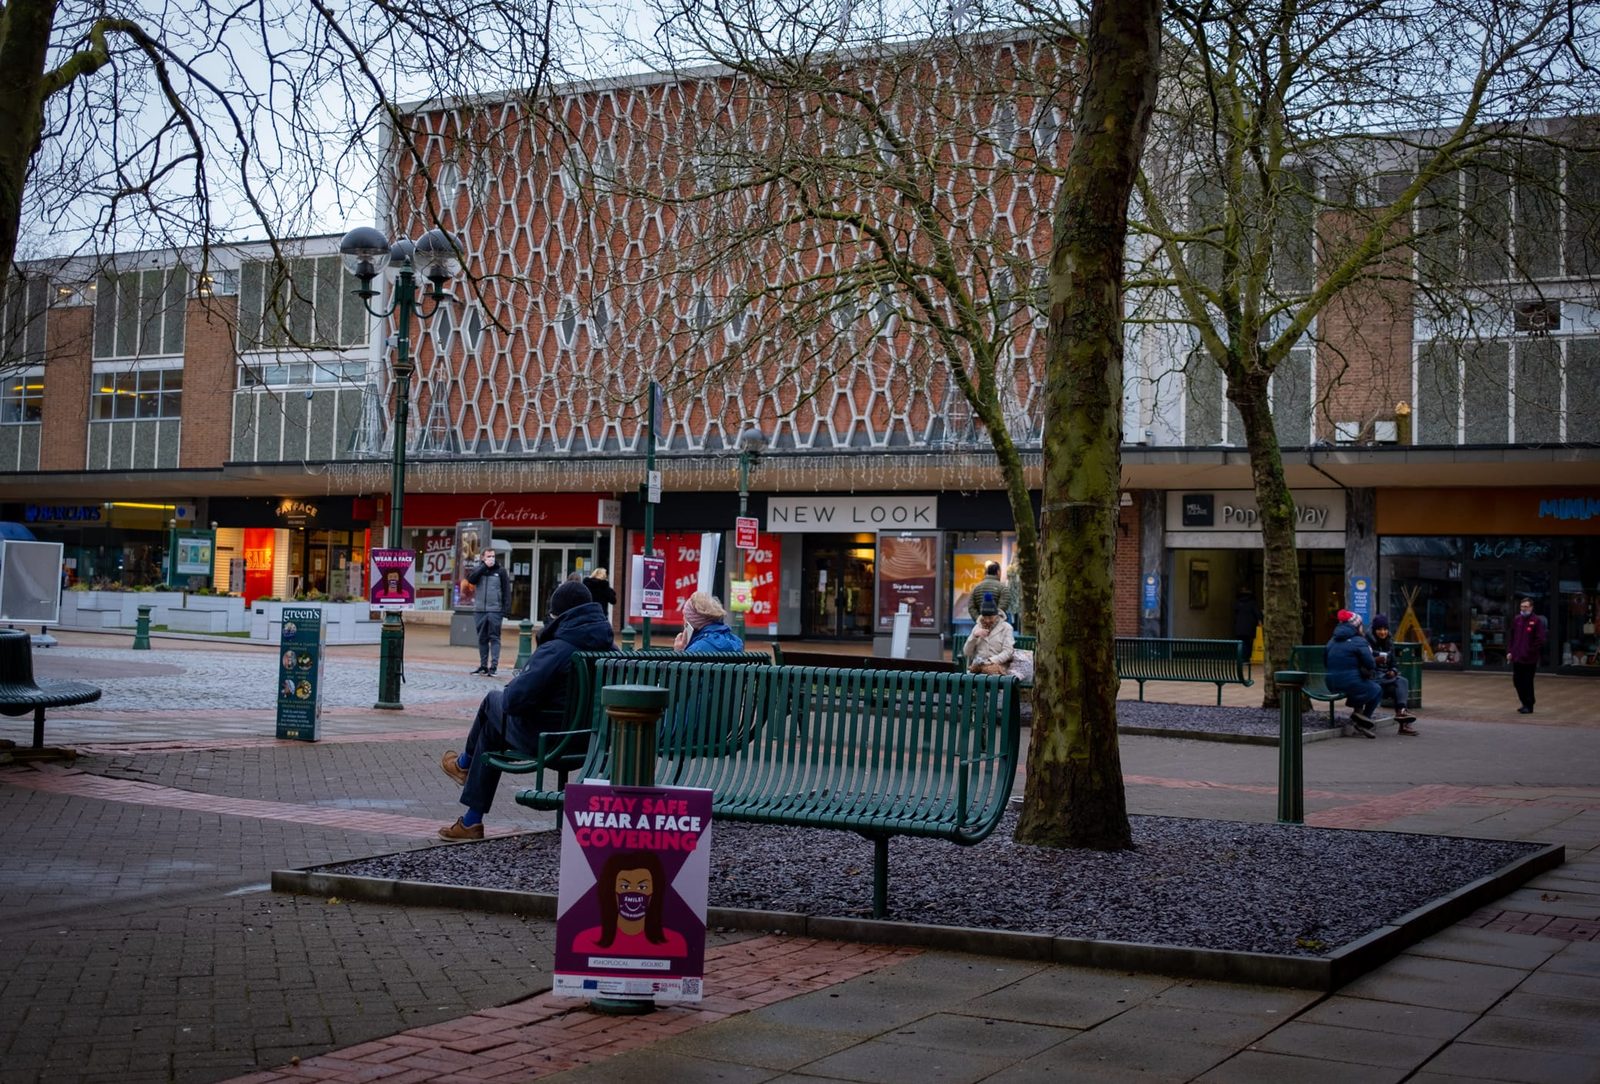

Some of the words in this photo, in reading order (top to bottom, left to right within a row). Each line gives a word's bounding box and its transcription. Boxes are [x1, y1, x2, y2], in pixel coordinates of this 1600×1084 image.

[40, 506, 99, 520] BARCLAYS
[480, 499, 548, 521] Clintons
[773, 507, 835, 522] NEW
[853, 506, 930, 522] LOOK
[427, 538, 451, 551] SALE
[245, 551, 271, 570] SALE
[675, 573, 699, 589] SAL
[752, 571, 773, 588] ALE
[283, 609, 320, 622] green's
[589, 796, 636, 812] STAY
[642, 800, 688, 815] SAFE
[574, 811, 632, 829] WEAR
[636, 814, 650, 829] A
[655, 815, 701, 831] FACE
[576, 827, 697, 851] COVERING
